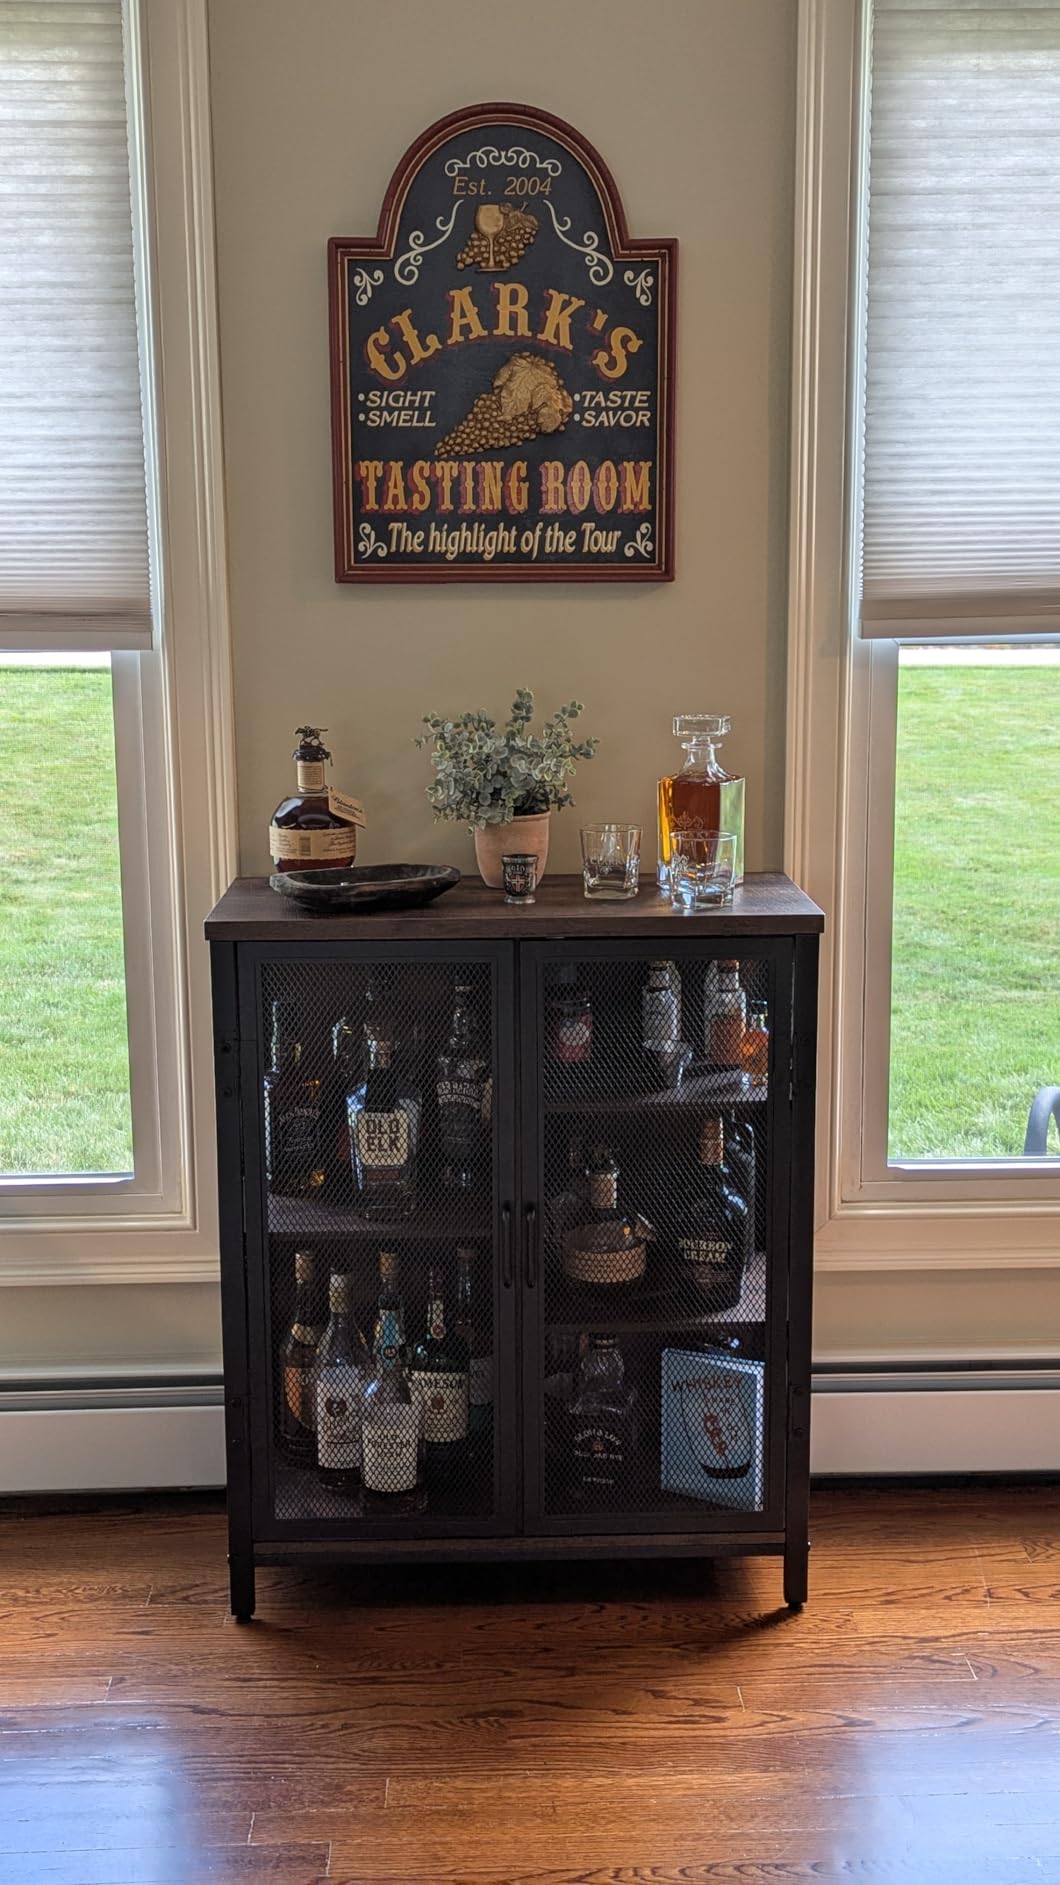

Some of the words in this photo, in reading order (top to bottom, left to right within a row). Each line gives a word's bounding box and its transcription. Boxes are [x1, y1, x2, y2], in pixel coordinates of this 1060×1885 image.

[452, 176, 492, 195] Est.
[504, 176, 552, 195] 2004
[366, 283, 643, 380] CLARK'S
[366, 390, 436, 407] SIGHT
[581, 390, 651, 407] TASTE
[366, 411, 437, 428] SMELL
[581, 411, 651, 428] SAVOR
[357, 460, 529, 513] TASTING
[539, 460, 652, 514] ROOM
[388, 522, 424, 553] The
[429, 522, 517, 560] highlight
[521, 523, 543, 560] of
[545, 522, 577, 553] the
[581, 521, 621, 553] Tour
[366, 1119, 400, 1134] OLD
[367, 1135, 401, 1151] ELK
[684, 1250, 727, 1264] CREAM
